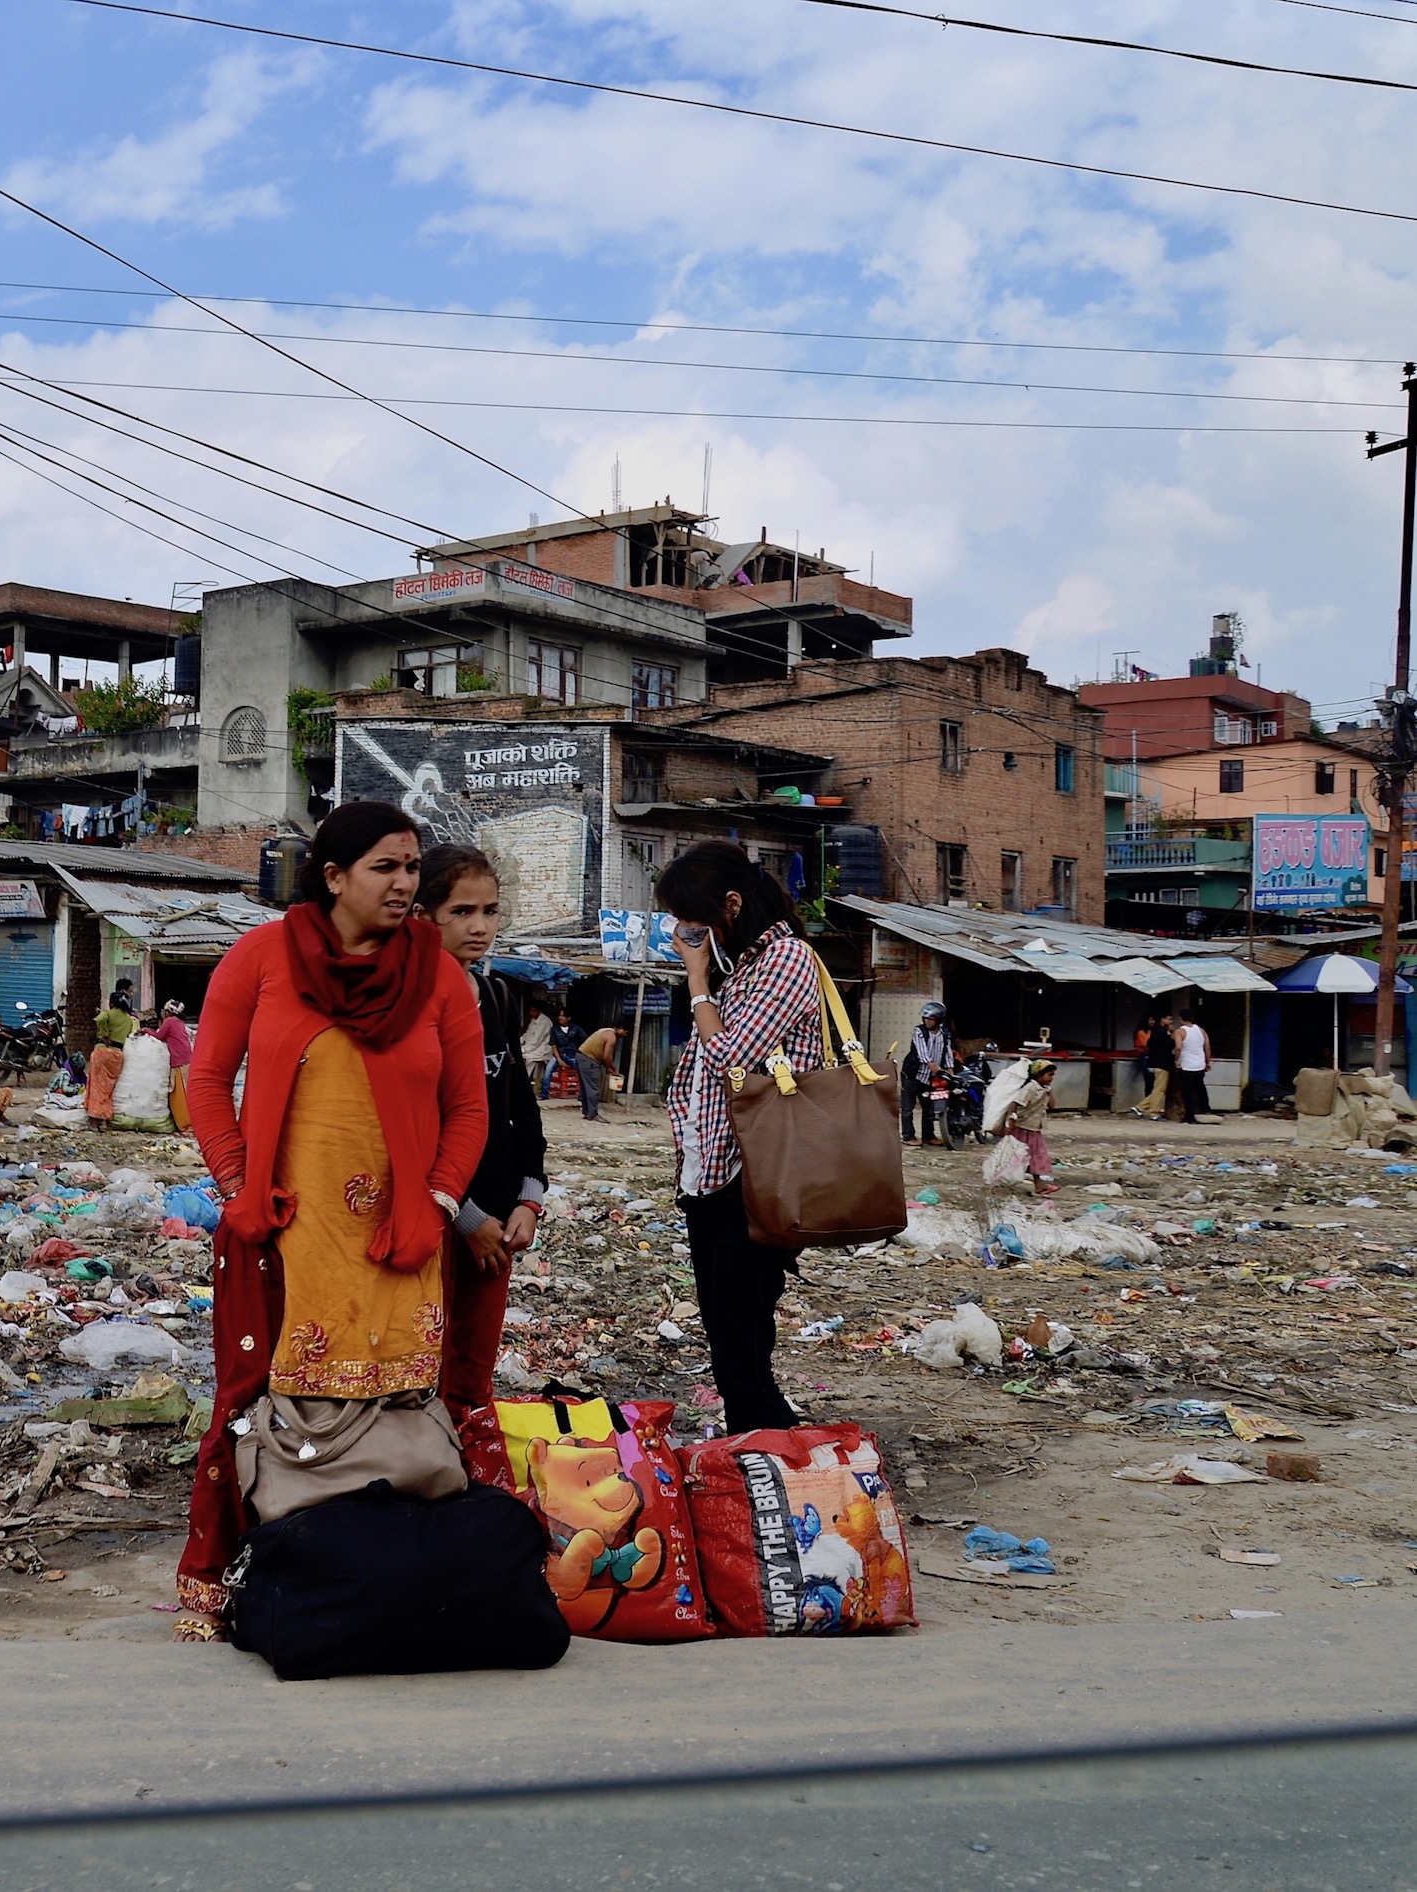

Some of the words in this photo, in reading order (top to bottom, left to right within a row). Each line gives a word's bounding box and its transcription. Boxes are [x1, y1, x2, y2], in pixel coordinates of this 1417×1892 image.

[395, 579, 427, 599] होटल
[504, 565, 528, 585] होटल
[464, 742, 528, 770] पूजाको
[530, 738, 579, 762] शक्ति
[465, 772, 497, 789] अब
[500, 761, 581, 787] महाशक्ति
[740, 1453, 780, 1512] BRUIN
[759, 1514, 788, 1560] THE
[766, 1563, 799, 1632] HAPPY
